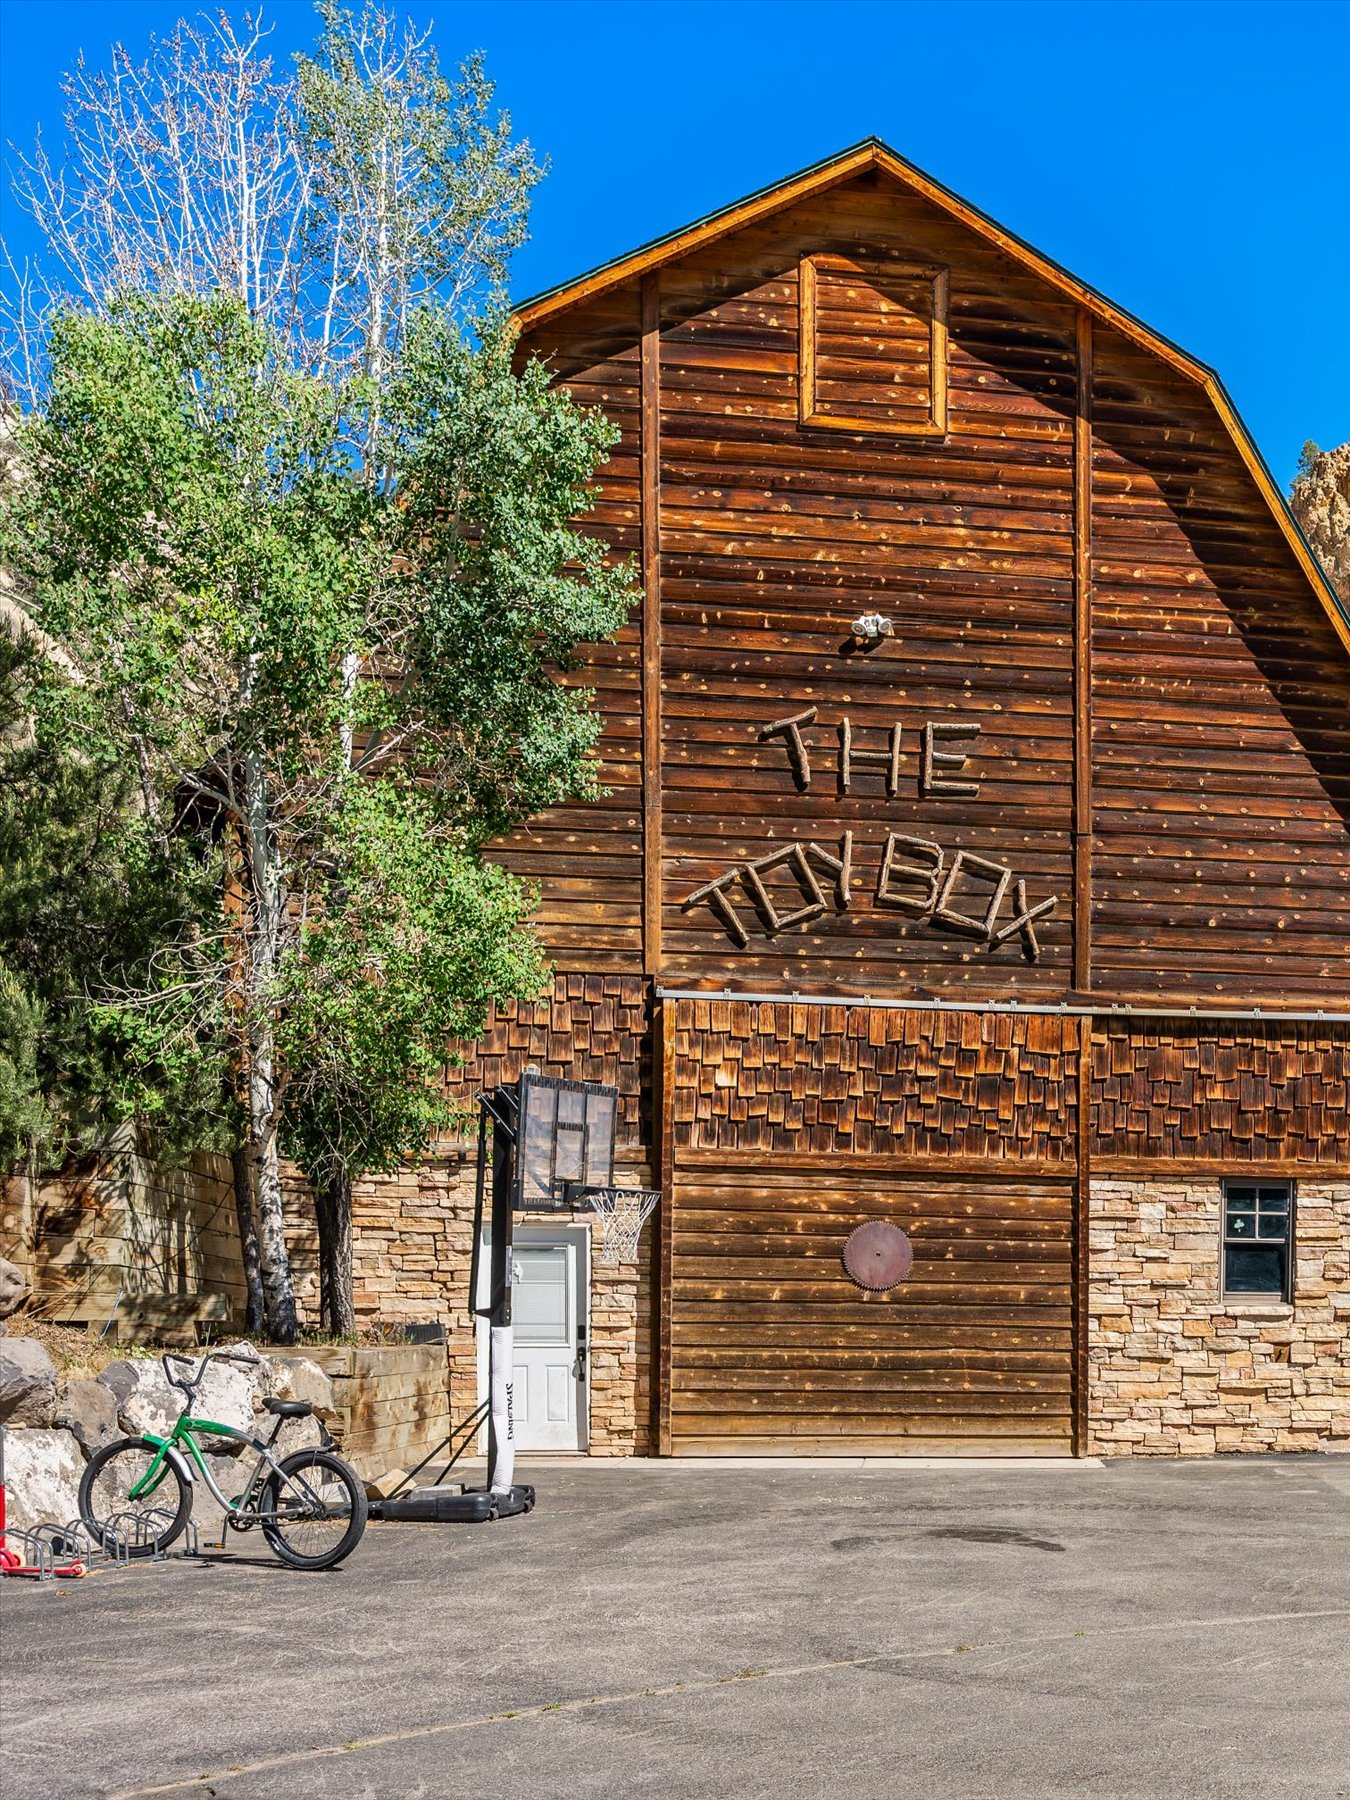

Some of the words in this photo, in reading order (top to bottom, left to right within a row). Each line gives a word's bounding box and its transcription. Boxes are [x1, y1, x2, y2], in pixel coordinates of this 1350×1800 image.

[762, 706, 981, 791] THE
[686, 829, 853, 943] TOY
[878, 832, 1059, 957] BOX
